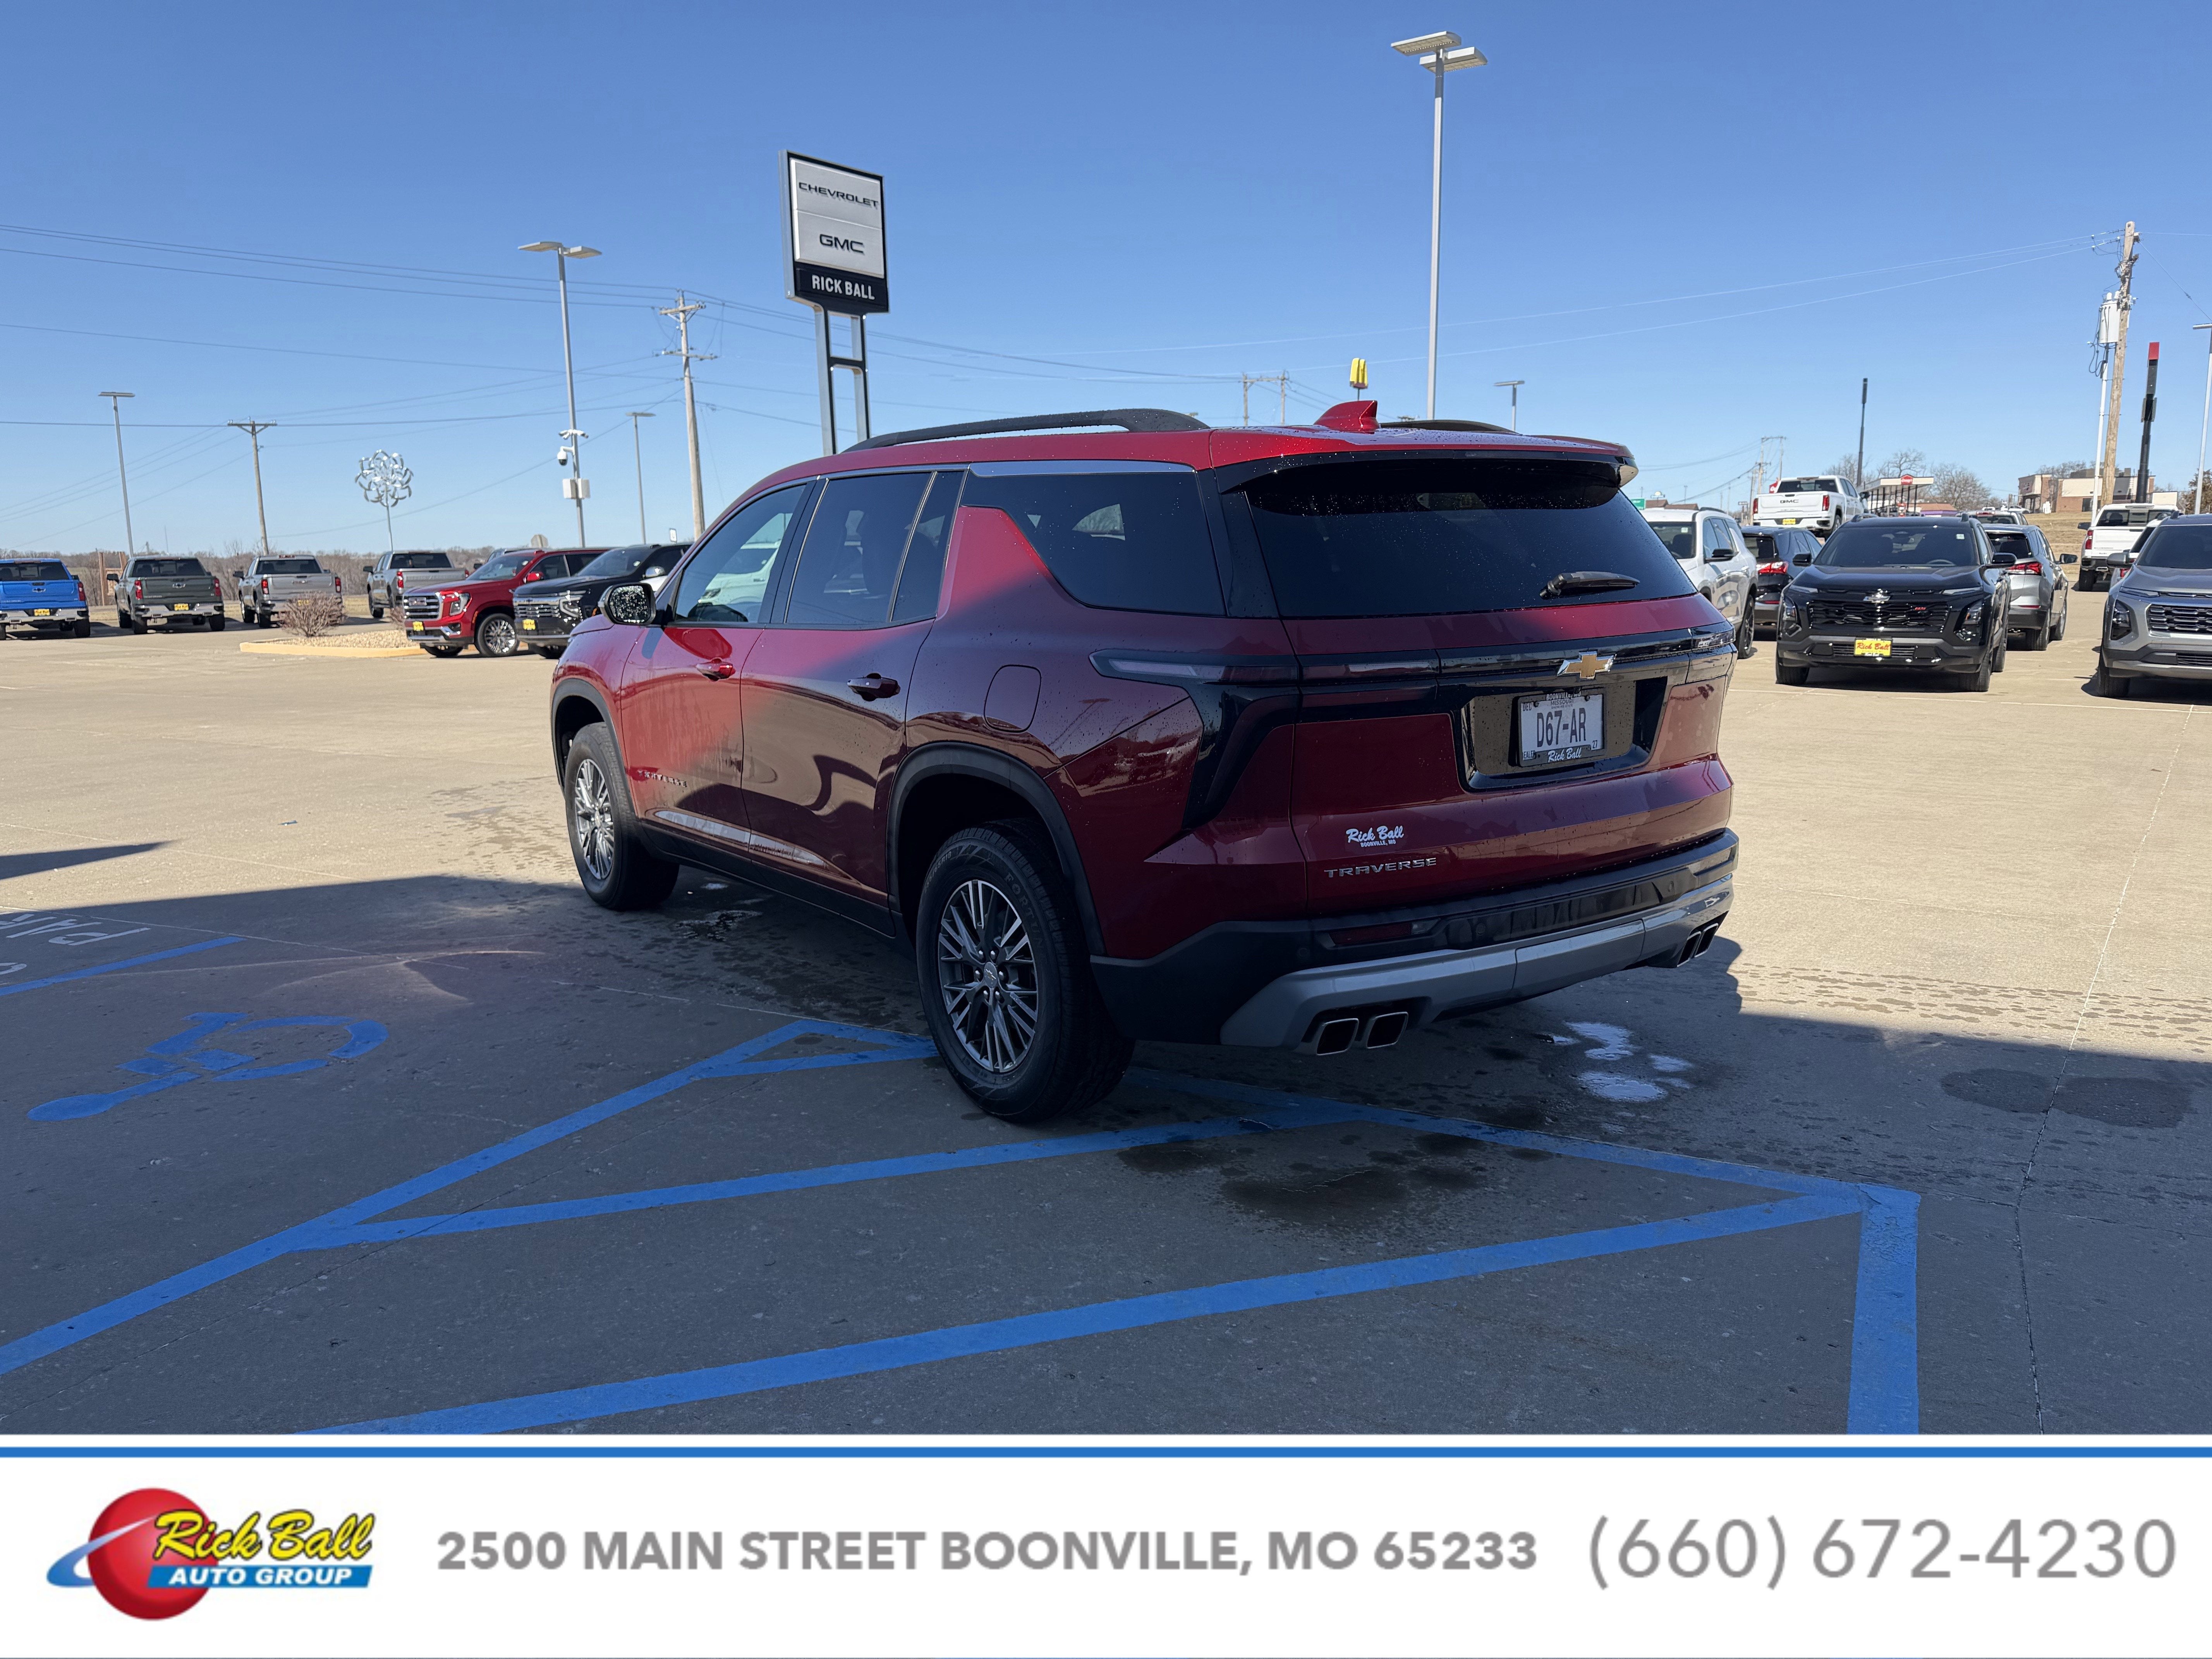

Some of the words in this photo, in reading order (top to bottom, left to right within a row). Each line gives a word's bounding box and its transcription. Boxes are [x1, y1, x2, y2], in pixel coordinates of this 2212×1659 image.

[799, 182, 879, 207] CHEVROLET
[820, 234, 864, 254] GMC
[812, 274, 843, 294] RICK
[845, 282, 875, 300] BALL
[1523, 702, 1532, 711] DEC
[1537, 708, 1586, 747] D67-AR
[1592, 740, 1597, 749] 27
[1548, 750, 1565, 763] Rick
[1566, 747, 1582, 759] Ball
[1346, 828, 1375, 843] Rick
[1377, 826, 1404, 840] Ball
[1324, 857, 1436, 878] TRAVERSE
